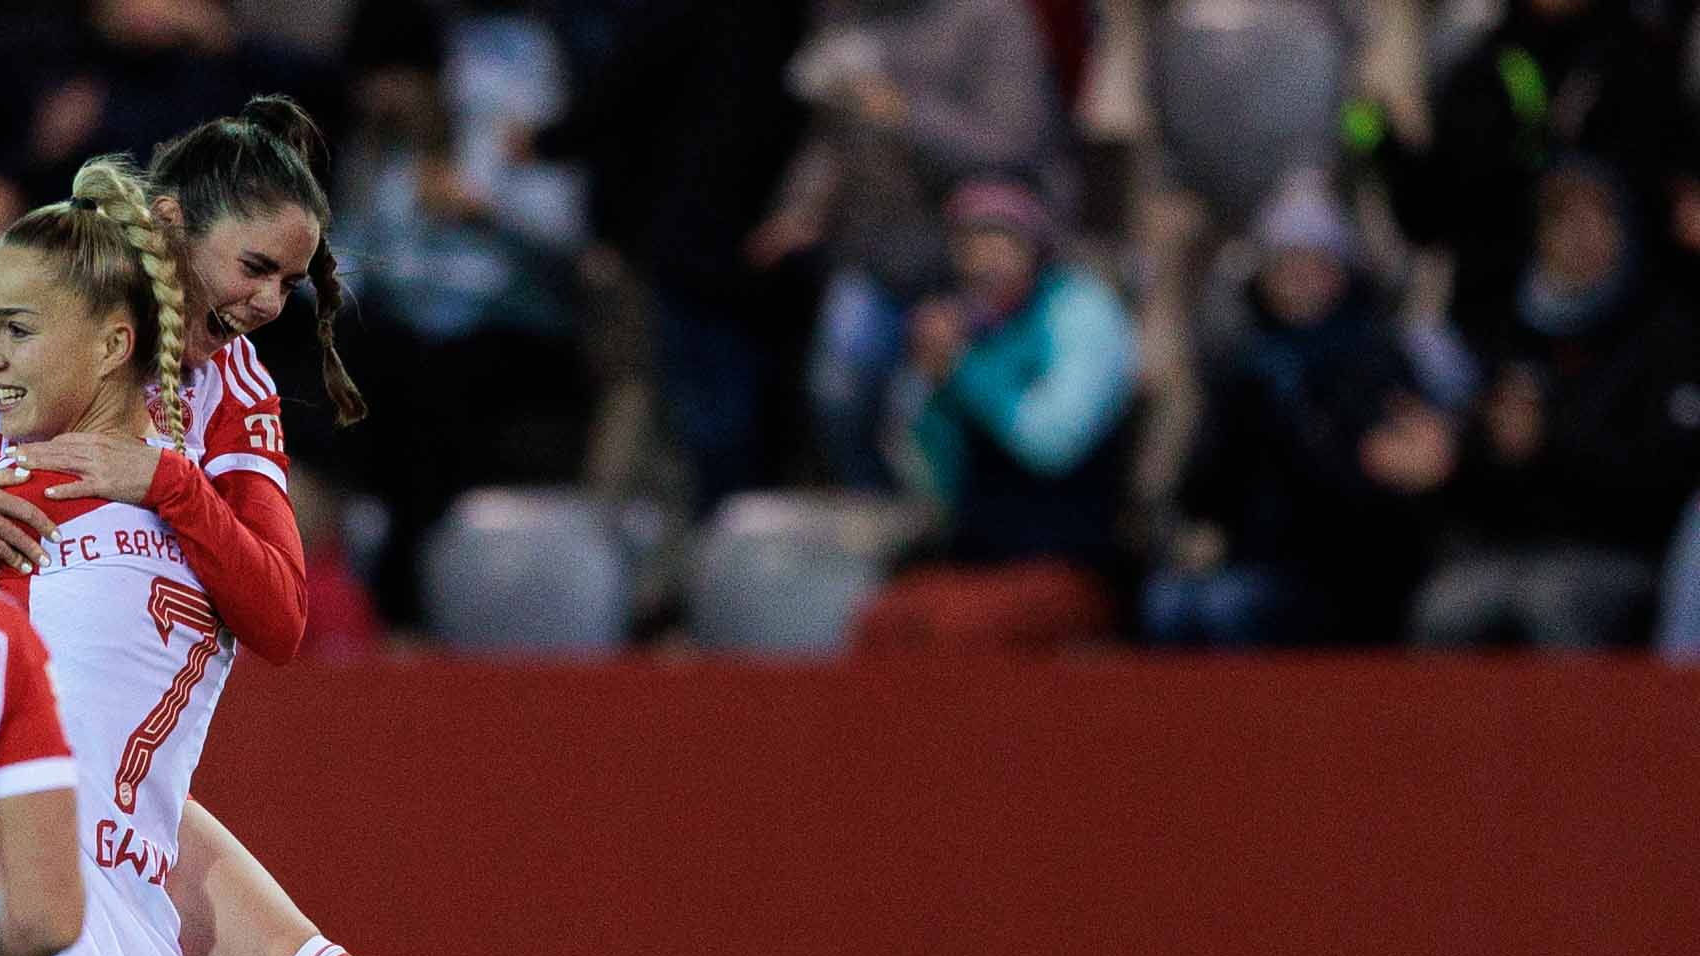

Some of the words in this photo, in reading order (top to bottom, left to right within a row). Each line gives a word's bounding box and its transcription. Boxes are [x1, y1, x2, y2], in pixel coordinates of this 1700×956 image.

[60, 535, 100, 567] FC
[115, 529, 187, 565] BAYE
[113, 575, 220, 814] 7
